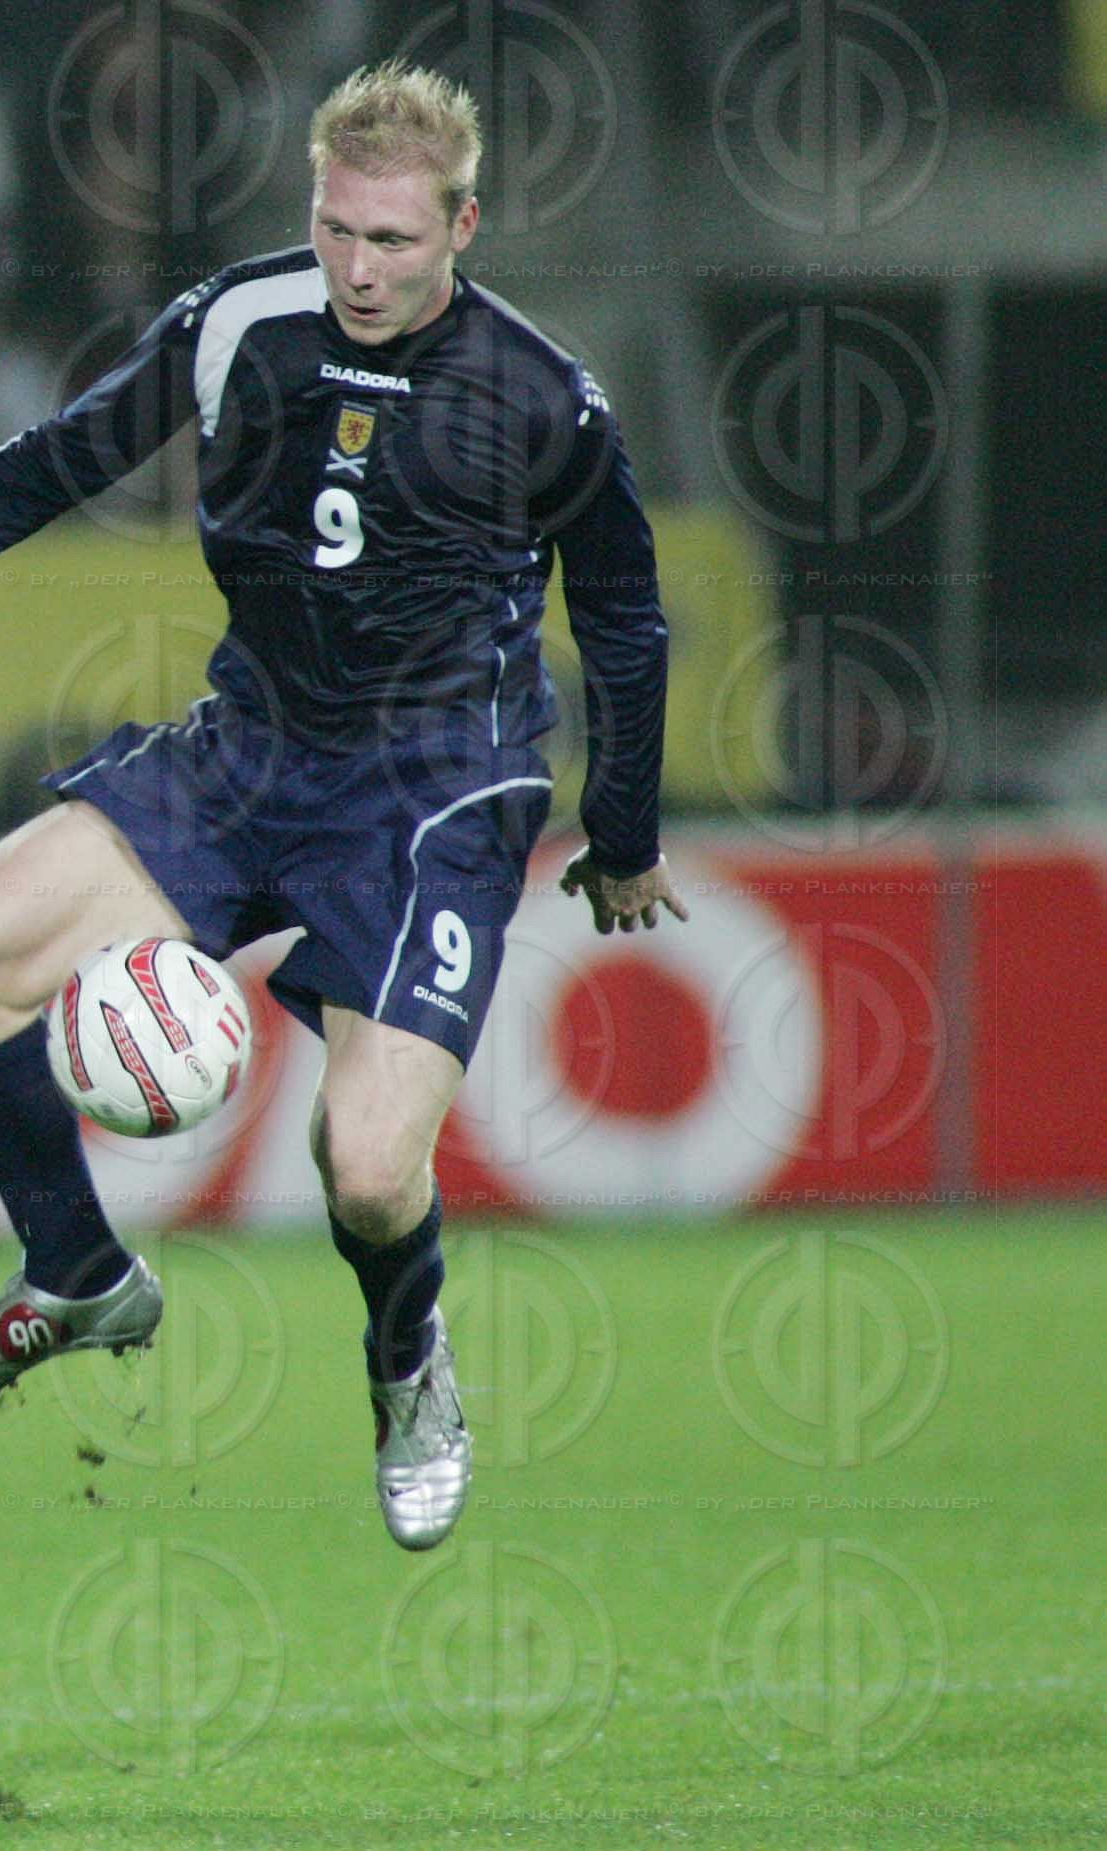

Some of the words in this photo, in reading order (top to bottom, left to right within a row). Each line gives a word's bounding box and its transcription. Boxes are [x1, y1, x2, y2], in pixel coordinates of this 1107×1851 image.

[321, 364, 411, 393] DIADORA
[313, 488, 365, 569] 9
[433, 909, 472, 993] 9
[413, 984, 470, 1023] DIADORA
